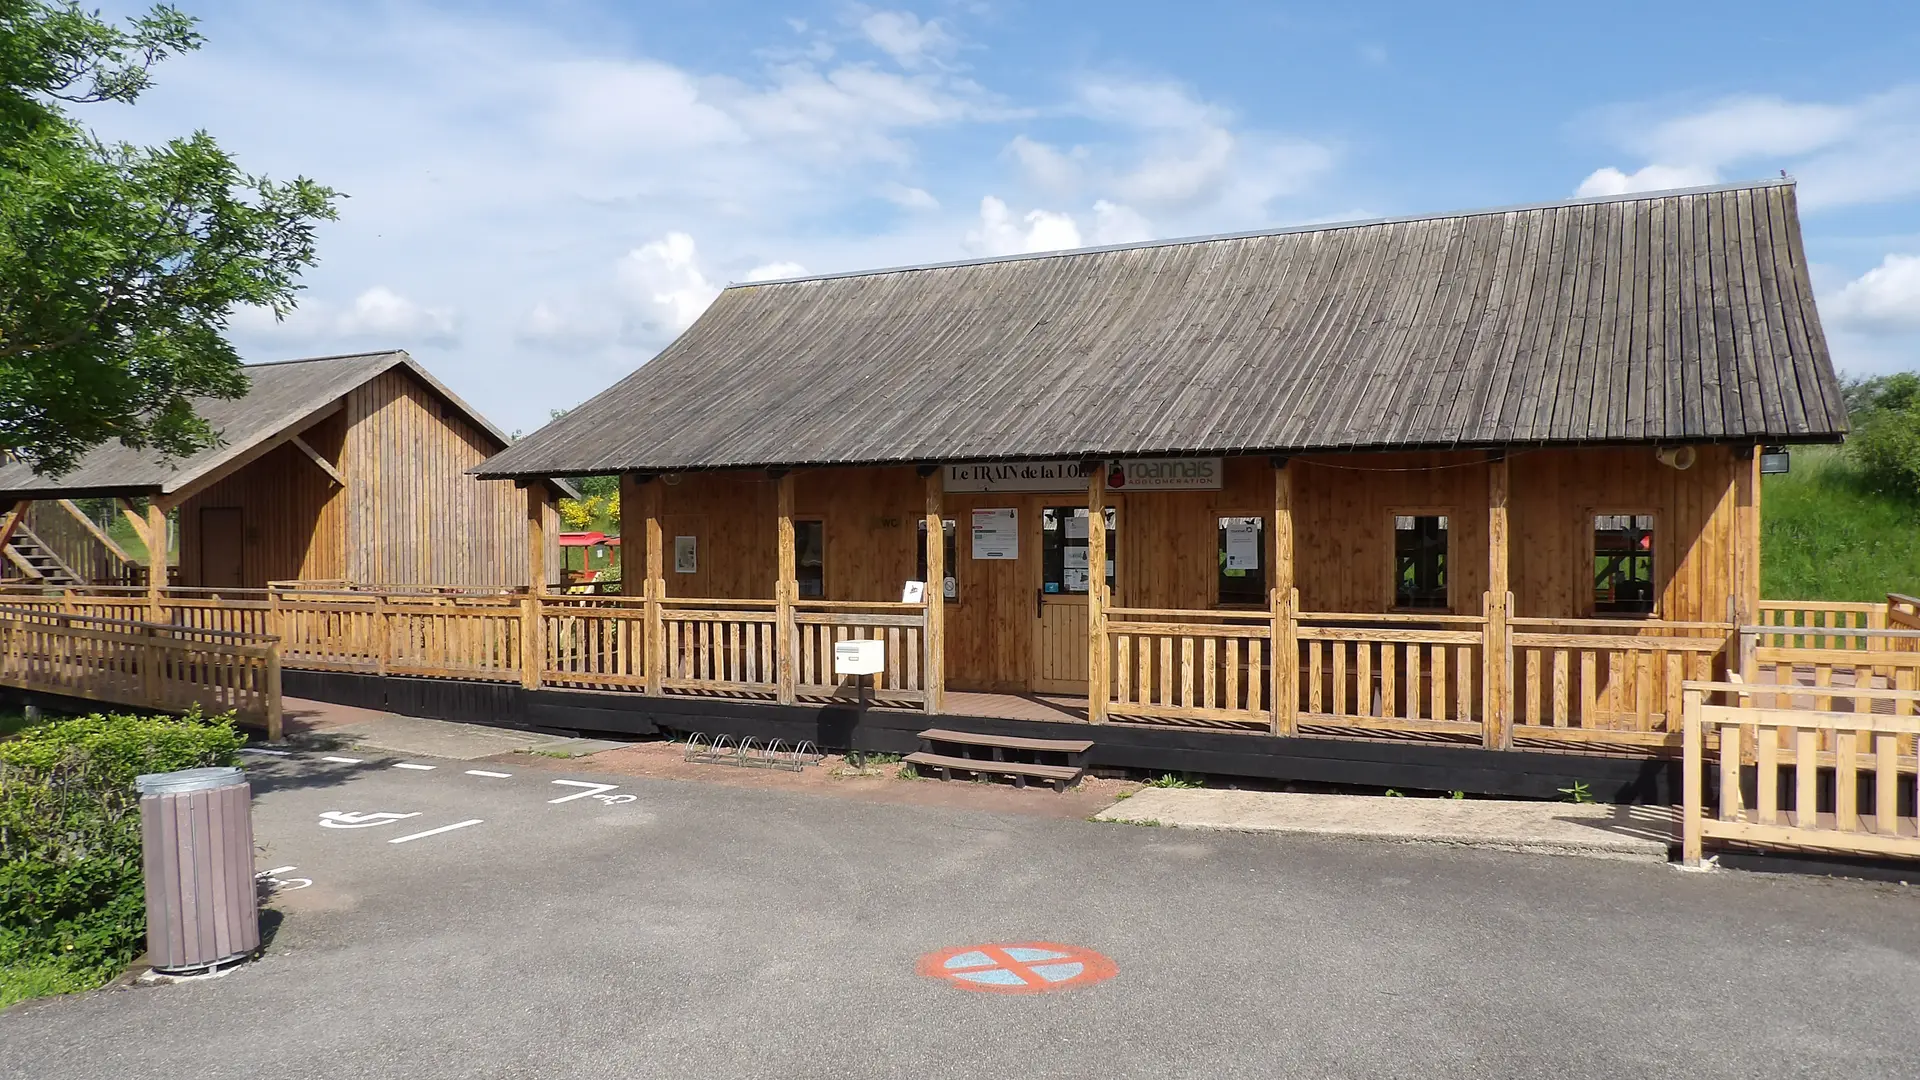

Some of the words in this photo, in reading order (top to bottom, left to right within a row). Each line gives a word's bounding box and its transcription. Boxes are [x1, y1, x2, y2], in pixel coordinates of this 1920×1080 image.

[951, 466, 969, 480] Le
[971, 465, 1018, 483] TRAIN
[1020, 465, 1037, 479] de
[1040, 464, 1054, 479] la
[1128, 461, 1214, 478] roannais
[881, 518, 898, 528] WC
